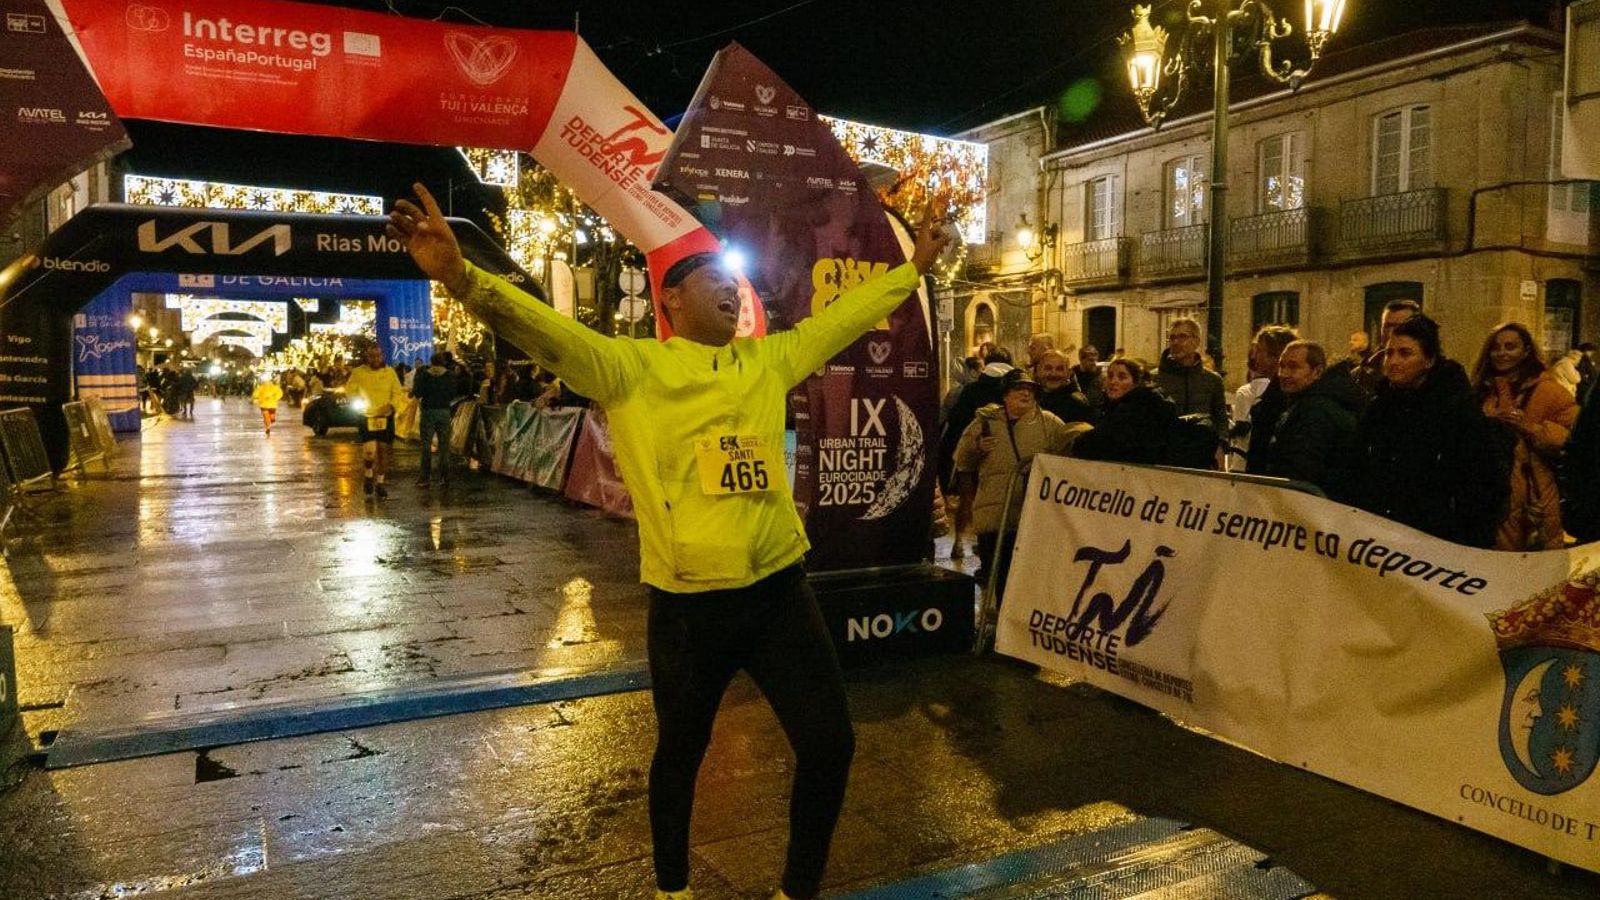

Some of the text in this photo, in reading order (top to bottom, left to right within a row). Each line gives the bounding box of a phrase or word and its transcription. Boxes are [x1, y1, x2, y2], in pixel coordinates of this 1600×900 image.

[183, 12, 332, 57] Interreg
[184, 44, 317, 72] EspañaPortugal
[18, 107, 66, 119] AVATEL
[440, 100, 529, 115] TUI VALENÇA
[560, 125, 634, 190] TUDENSE
[567, 115, 645, 182] DEPORTE
[715, 167, 750, 180] XENERA
[137, 219, 292, 258] KIA
[317, 233, 362, 252] Rias
[43, 256, 111, 273] blendio
[8, 335, 31, 345] Vigo
[851, 398, 887, 437] IX
[728, 449, 755, 461] SANTI
[819, 437, 887, 449] URBAN TRAIL
[720, 460, 769, 492] 465
[819, 450, 887, 472] NIGHT
[819, 471, 887, 483] EUROCIDADE
[818, 482, 876, 506] 2025
[1039, 476, 1051, 501] O
[1054, 479, 1136, 518] Concello
[1140, 495, 1169, 524] de
[1176, 500, 1211, 532] Tui
[1212, 511, 1308, 550] sempre
[1346, 537, 1489, 596] deporte
[847, 607, 944, 642] NOKO
[1028, 609, 1122, 657] DEPORTE
[1028, 628, 1120, 676] TUDENSE
[1459, 783, 1600, 841] CONCELLO DE T
